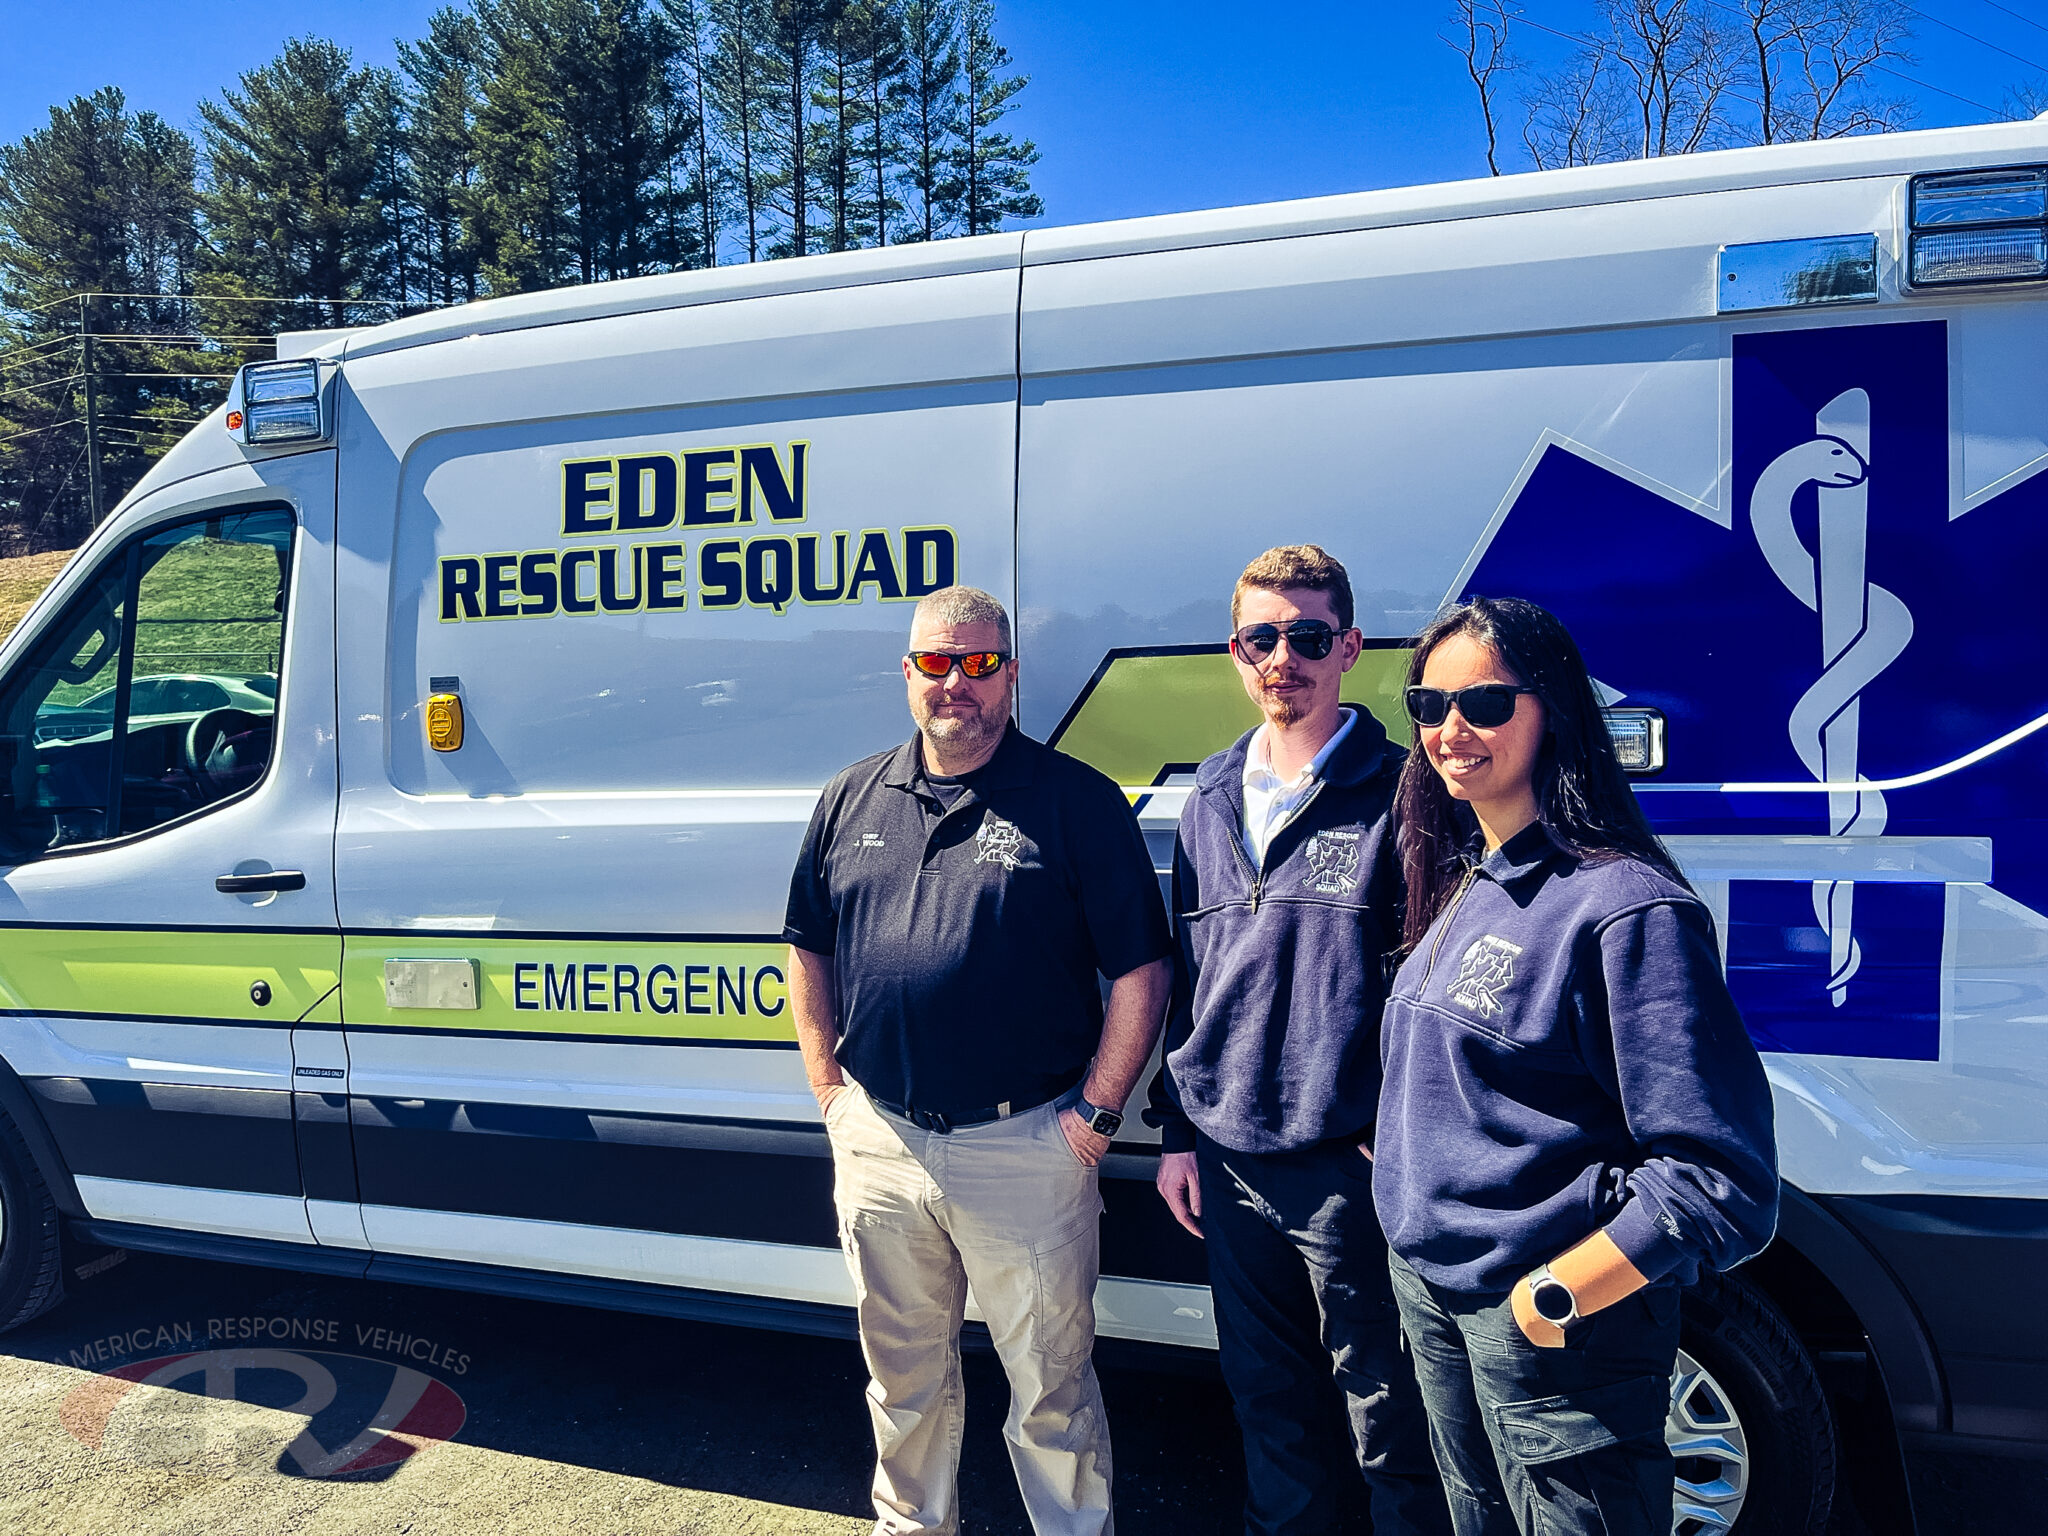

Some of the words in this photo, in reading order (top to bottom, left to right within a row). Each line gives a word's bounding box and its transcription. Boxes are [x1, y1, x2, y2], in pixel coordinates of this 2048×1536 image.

[561, 440, 811, 537] EDEN
[439, 542, 687, 623] RESCUE
[699, 524, 959, 617] SQUAD
[1315, 883, 1340, 892] SQUAD
[514, 962, 787, 1017] EMERGENC
